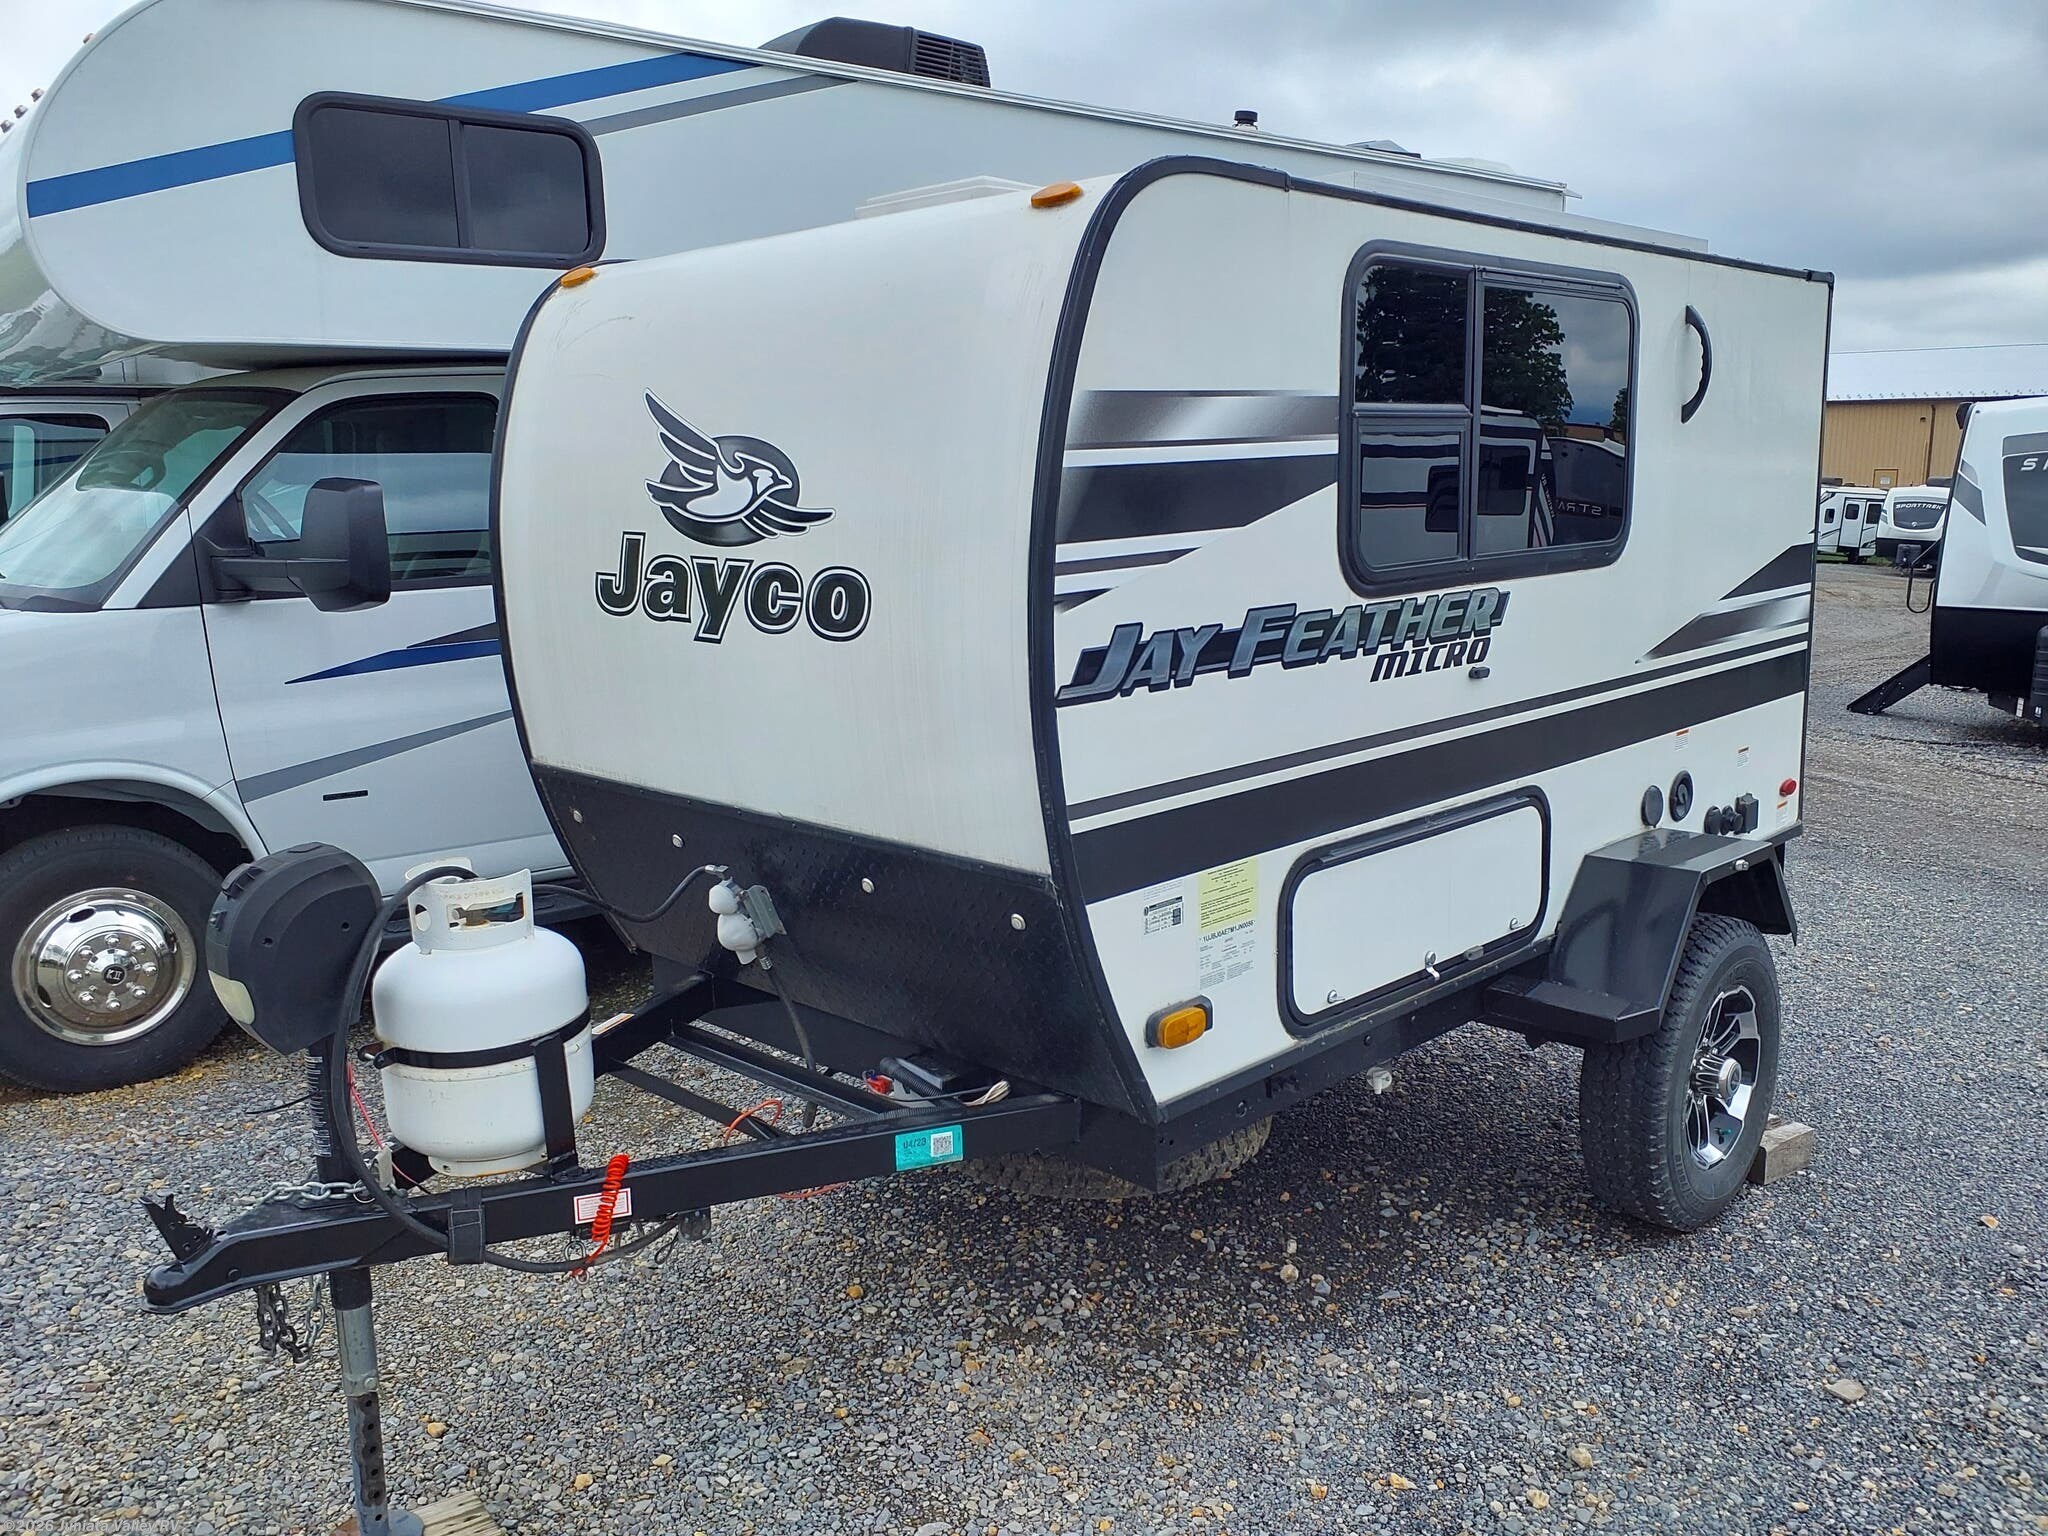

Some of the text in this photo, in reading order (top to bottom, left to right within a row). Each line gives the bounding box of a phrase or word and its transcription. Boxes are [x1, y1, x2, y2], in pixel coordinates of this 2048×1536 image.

[595, 531, 872, 644] Jayco
[1055, 587, 1503, 708] JAY FEATHER
[1370, 637, 1491, 683] MICRO
